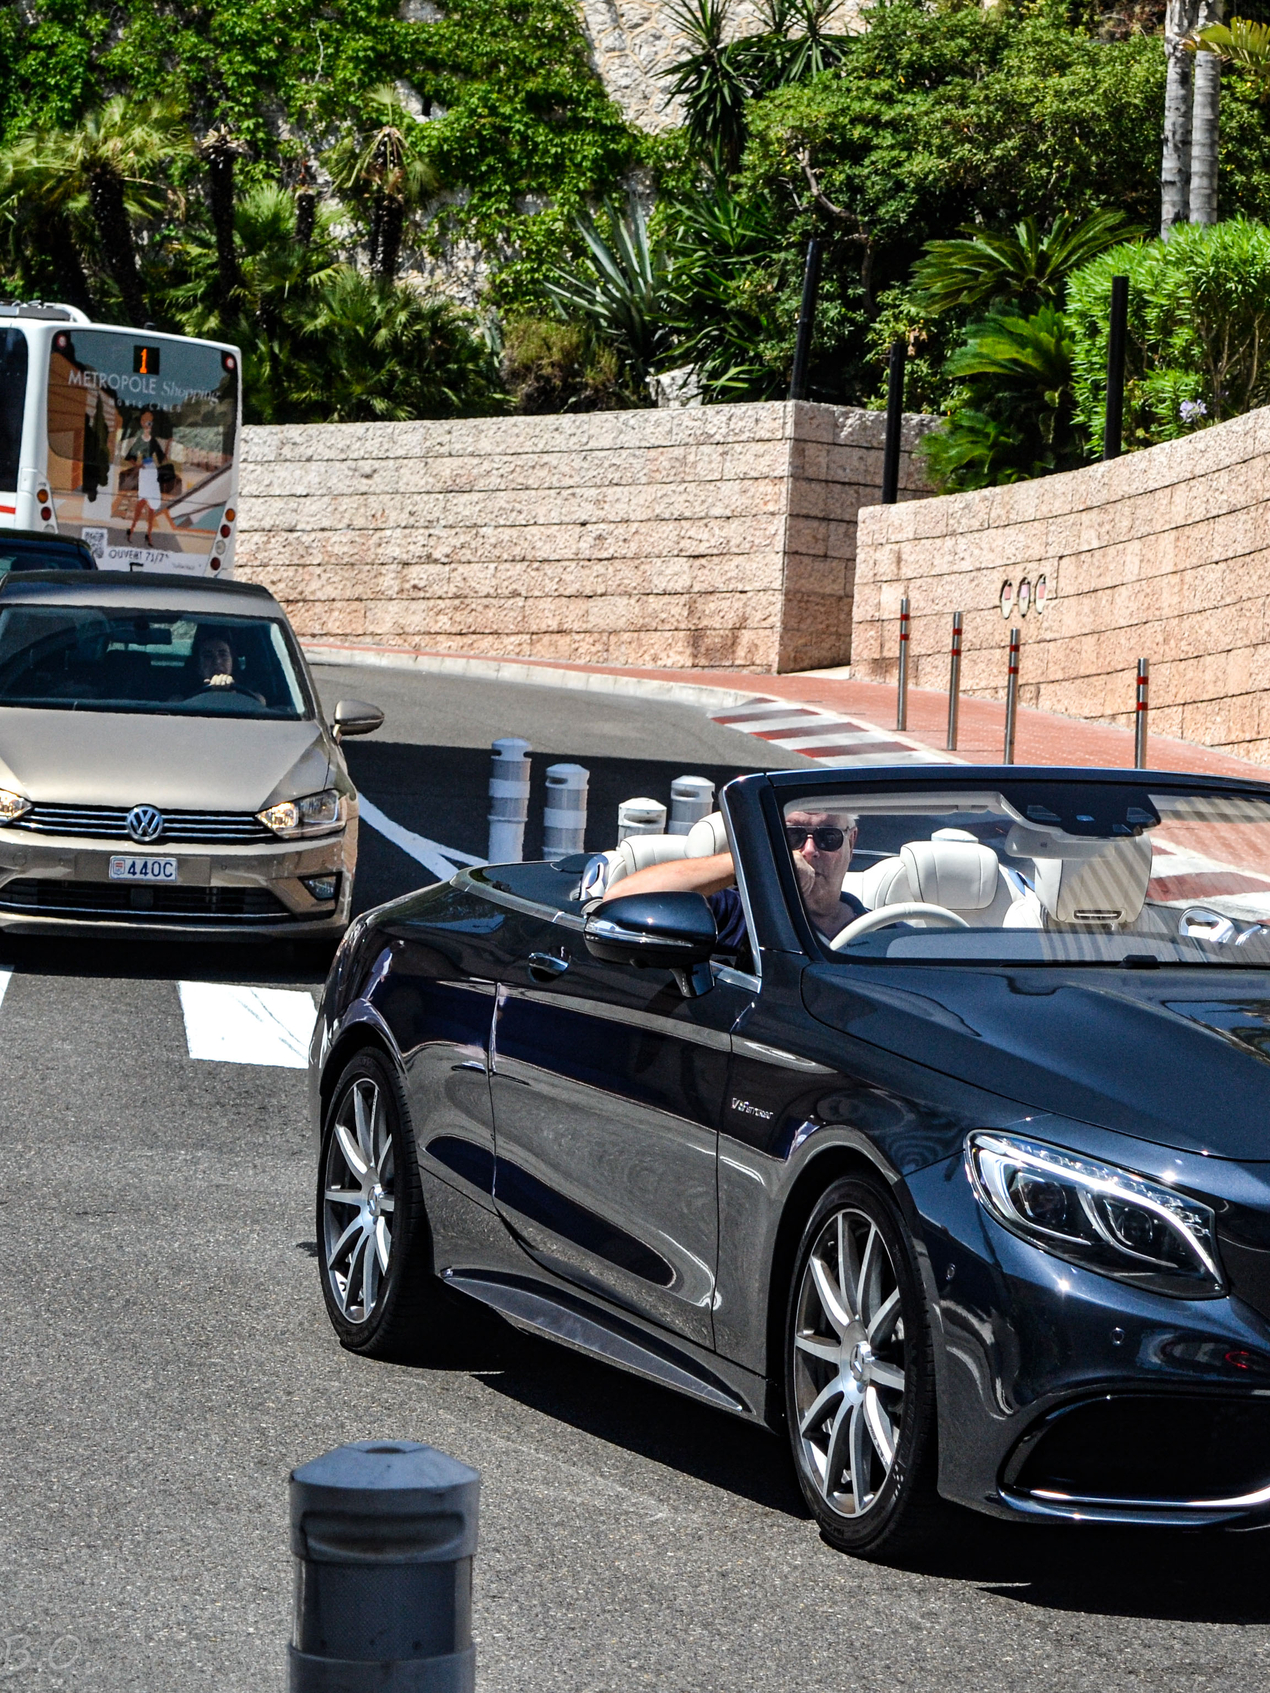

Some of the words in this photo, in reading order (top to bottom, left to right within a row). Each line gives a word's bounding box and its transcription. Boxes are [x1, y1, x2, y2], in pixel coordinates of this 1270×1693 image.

[139, 348, 148, 374] 1
[68, 369, 157, 395] METROPOLE
[161, 381, 221, 406] Shopping
[108, 549, 143, 560] OUVERT
[127, 860, 174, 878] 440C
